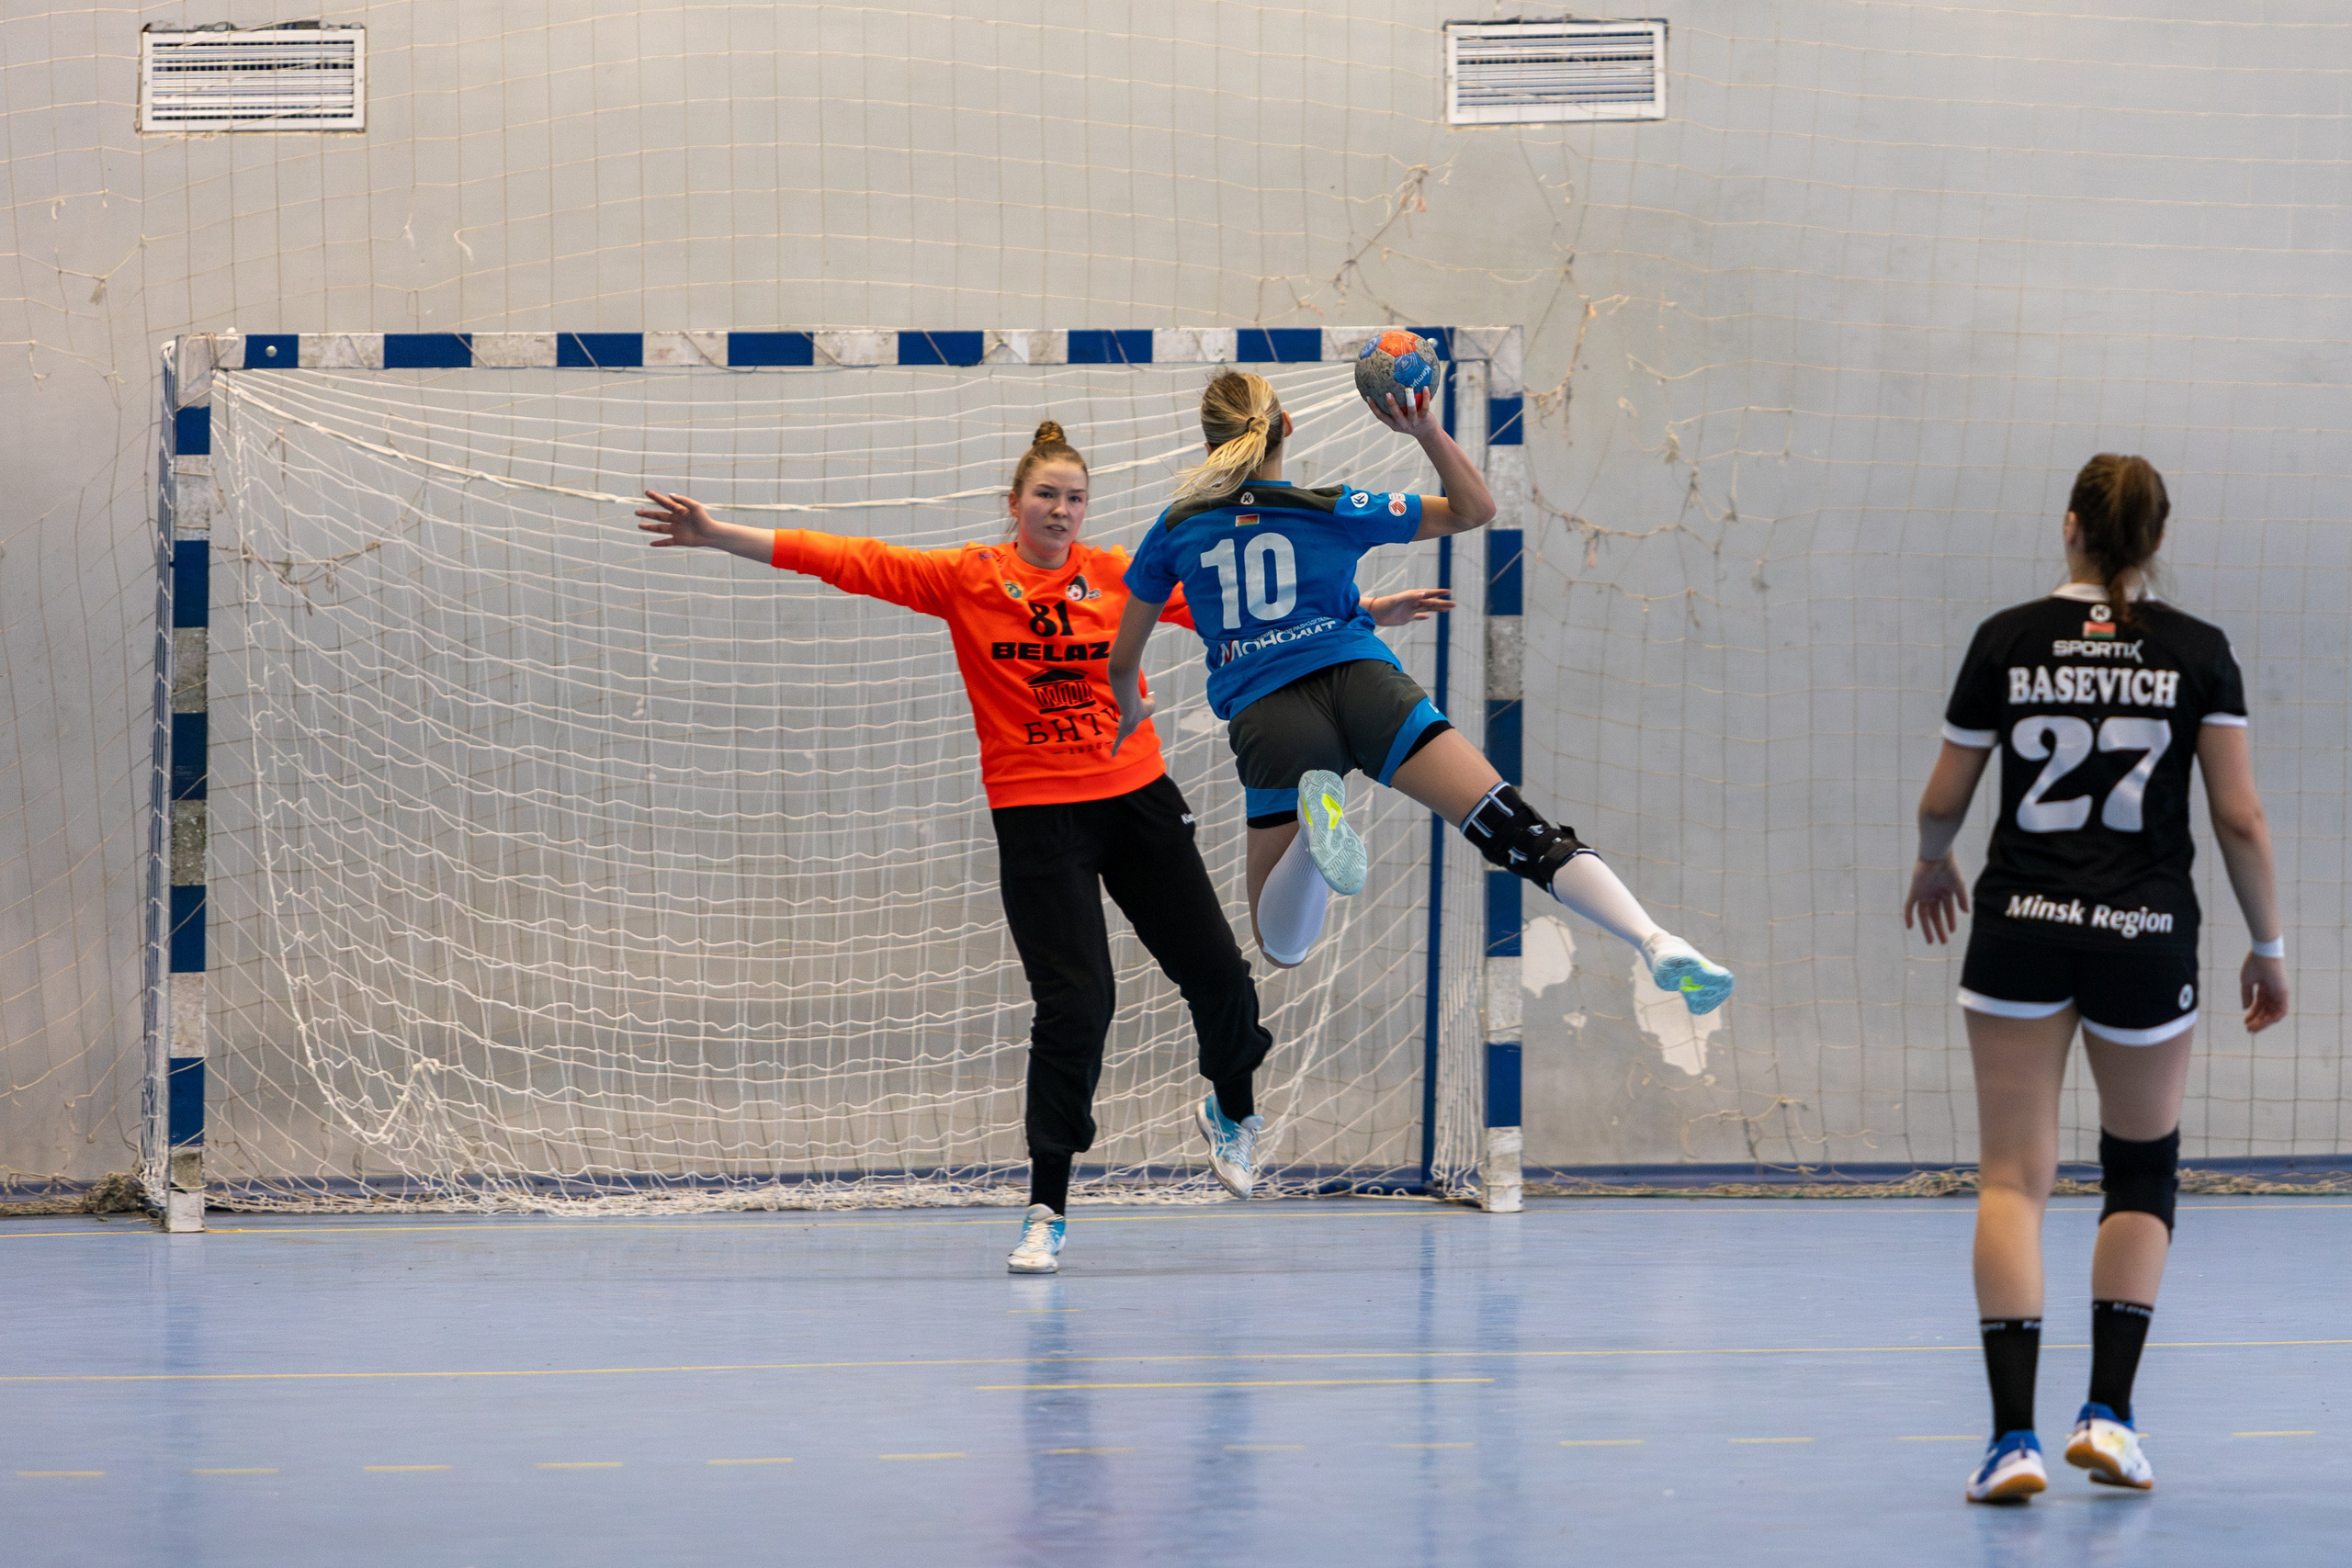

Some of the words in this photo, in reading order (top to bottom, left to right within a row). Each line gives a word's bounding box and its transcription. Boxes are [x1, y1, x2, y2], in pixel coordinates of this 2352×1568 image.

[1200, 532, 1297, 630] 10
[1028, 600, 1074, 637] 81
[992, 641, 1110, 661] BELAZ
[2008, 665, 2180, 708] BASEVICH
[2011, 715, 2172, 832] 27
[2005, 895, 2086, 925] Minsk
[2091, 904, 2174, 939] Region
